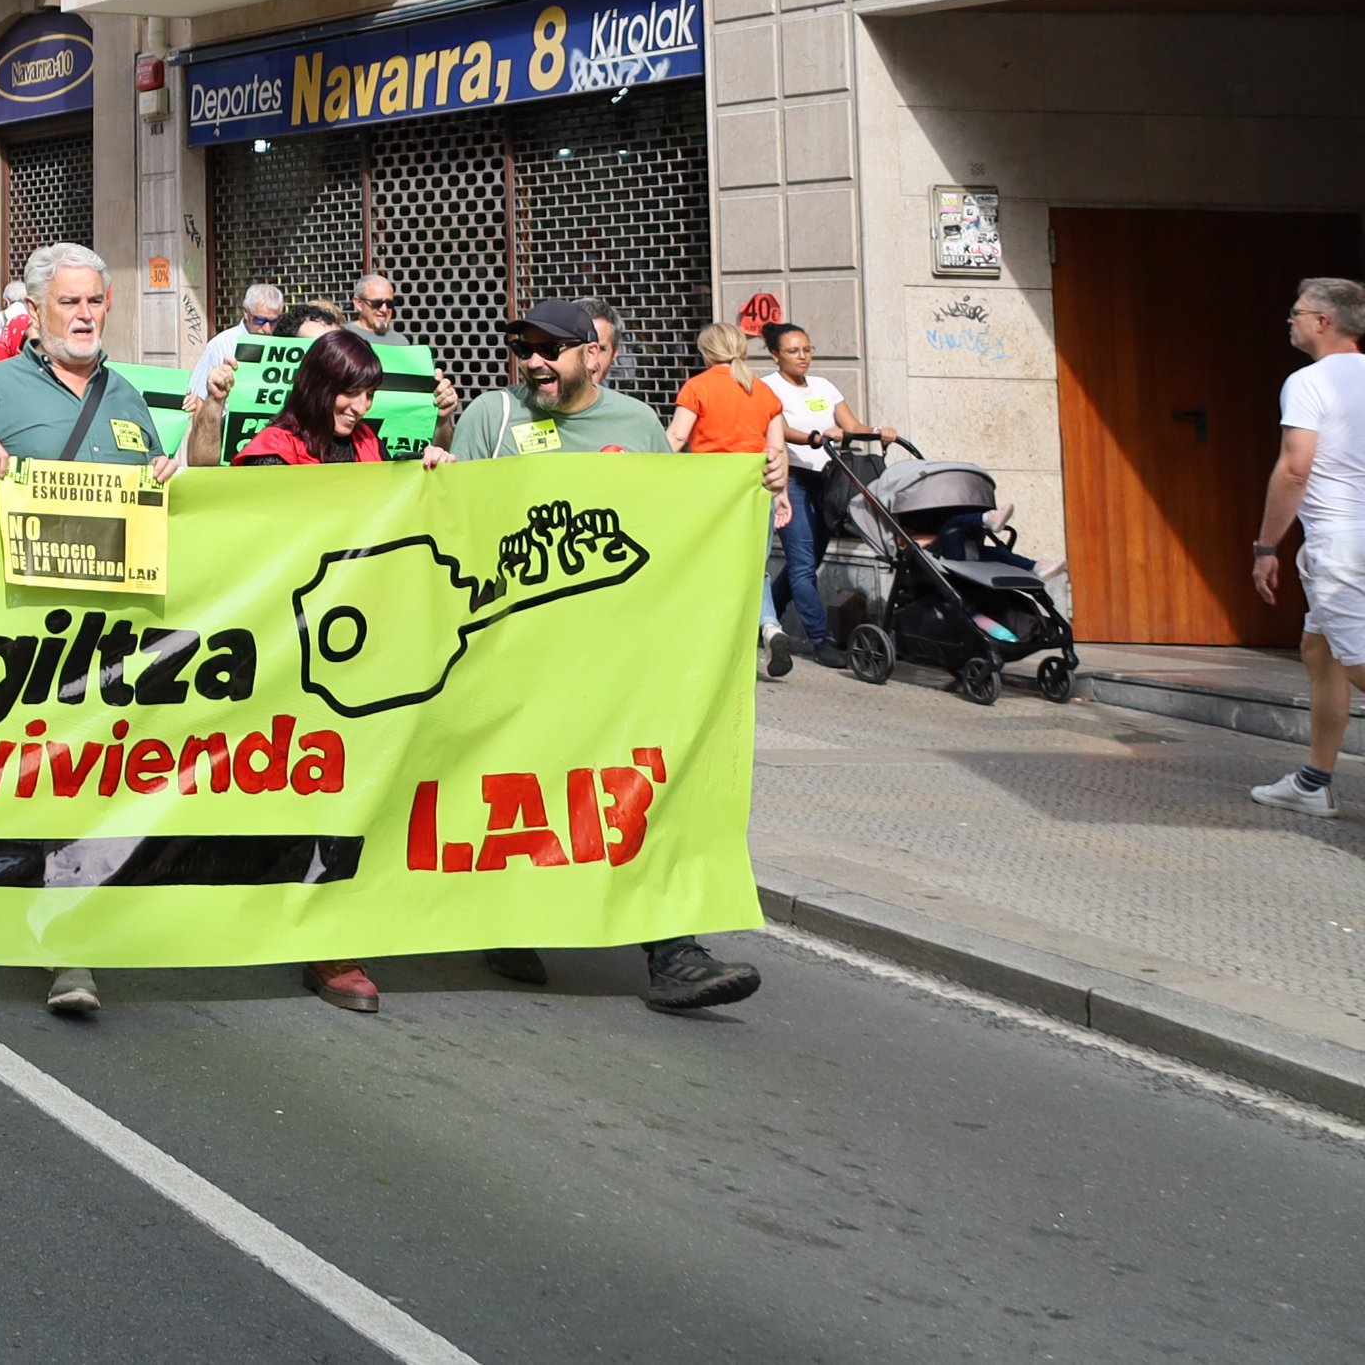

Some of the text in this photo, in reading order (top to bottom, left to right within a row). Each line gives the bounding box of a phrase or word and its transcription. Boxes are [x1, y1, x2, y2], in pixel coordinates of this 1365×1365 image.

[190, 74, 282, 126] Deportes
[290, 40, 510, 126] Navarra,
[528, 5, 567, 92] 8
[267, 346, 305, 363] NO
[383, 436, 432, 453] LAB
[32, 470, 122, 489] ETXEBIZITZA
[32, 485, 136, 505] ESKUBIDEA DA
[8, 514, 41, 541] NO
[10, 540, 97, 560] AL NEGOCIO
[11, 555, 125, 577] DE LA VIVIENDA
[128, 567, 158, 581] LAB
[407, 756, 664, 872] LAB
